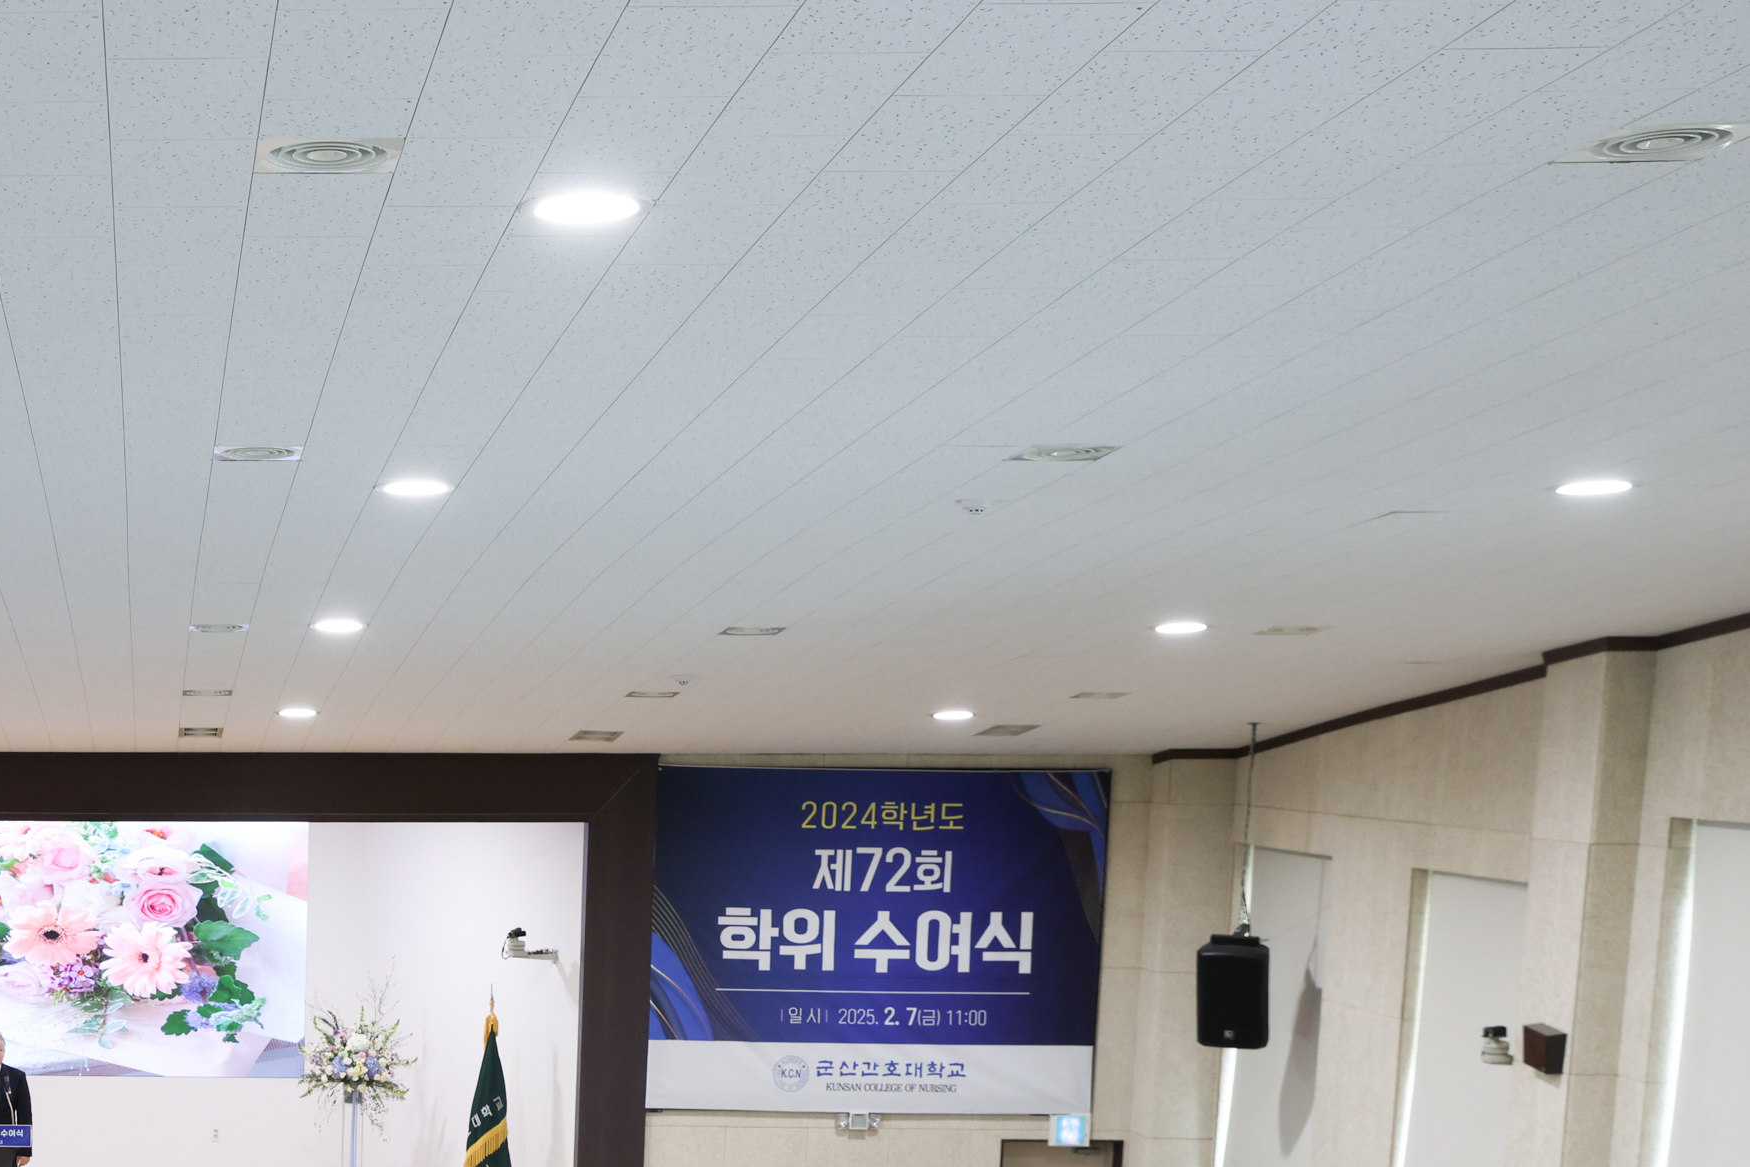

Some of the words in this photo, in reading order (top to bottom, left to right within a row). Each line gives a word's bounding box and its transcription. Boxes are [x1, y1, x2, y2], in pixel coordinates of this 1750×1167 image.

[801, 801, 964, 831] 2024학년도
[812, 847, 953, 893] 제72회
[717, 907, 836, 971] 학위
[854, 910, 1034, 974] 수여식
[838, 1008, 879, 1025] 2025.
[884, 1006, 900, 1026] 2.
[905, 1007, 941, 1026] 7(금)
[946, 1009, 987, 1026] 11:00
[815, 1060, 967, 1079] 군산간호대학교
[825, 1082, 862, 1092] KUNSAN
[863, 1083, 903, 1093] COLLEGE
[904, 1083, 917, 1093] OF
[918, 1084, 958, 1093] NURSING
[469, 1095, 504, 1136] 대학교
